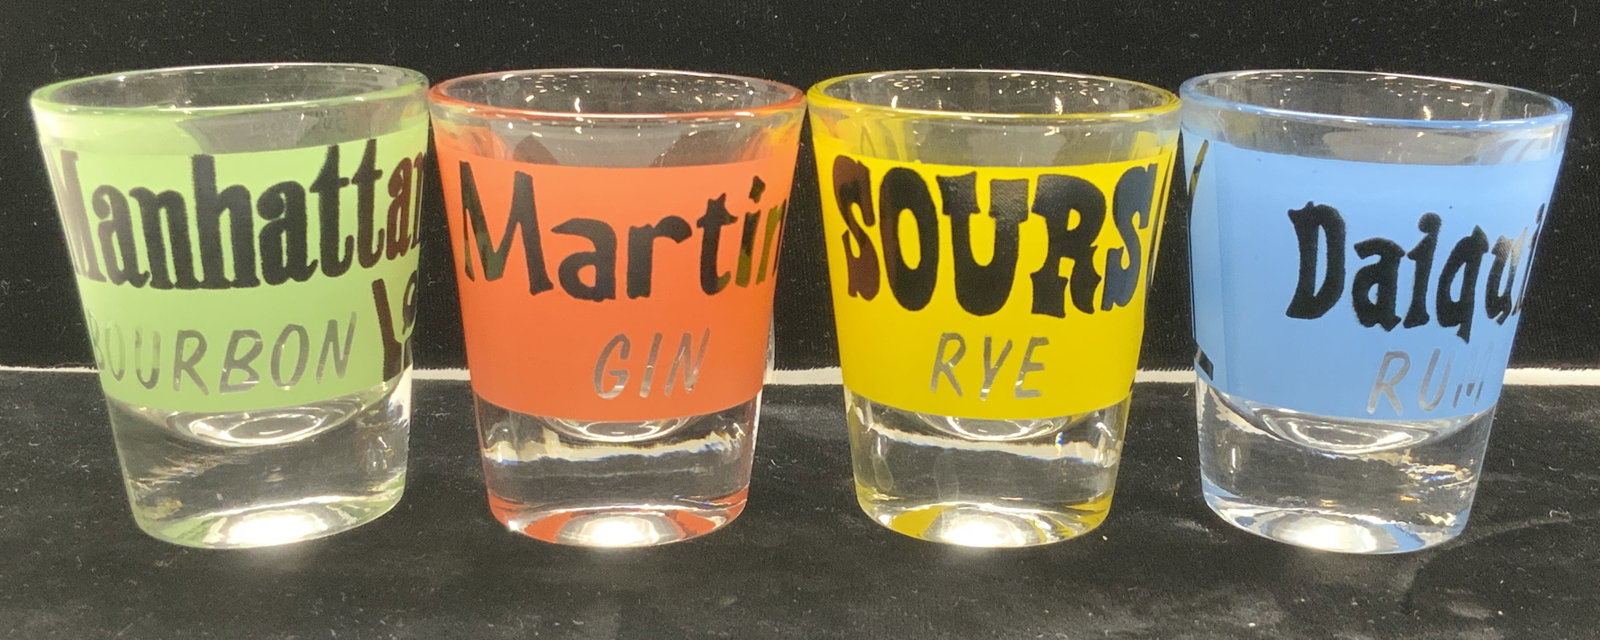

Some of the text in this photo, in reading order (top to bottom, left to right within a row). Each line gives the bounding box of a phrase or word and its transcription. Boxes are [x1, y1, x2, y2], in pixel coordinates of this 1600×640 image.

[832, 154, 1158, 318] SOURS
[593, 328, 711, 399] GIN
[929, 332, 1050, 401] RYE
